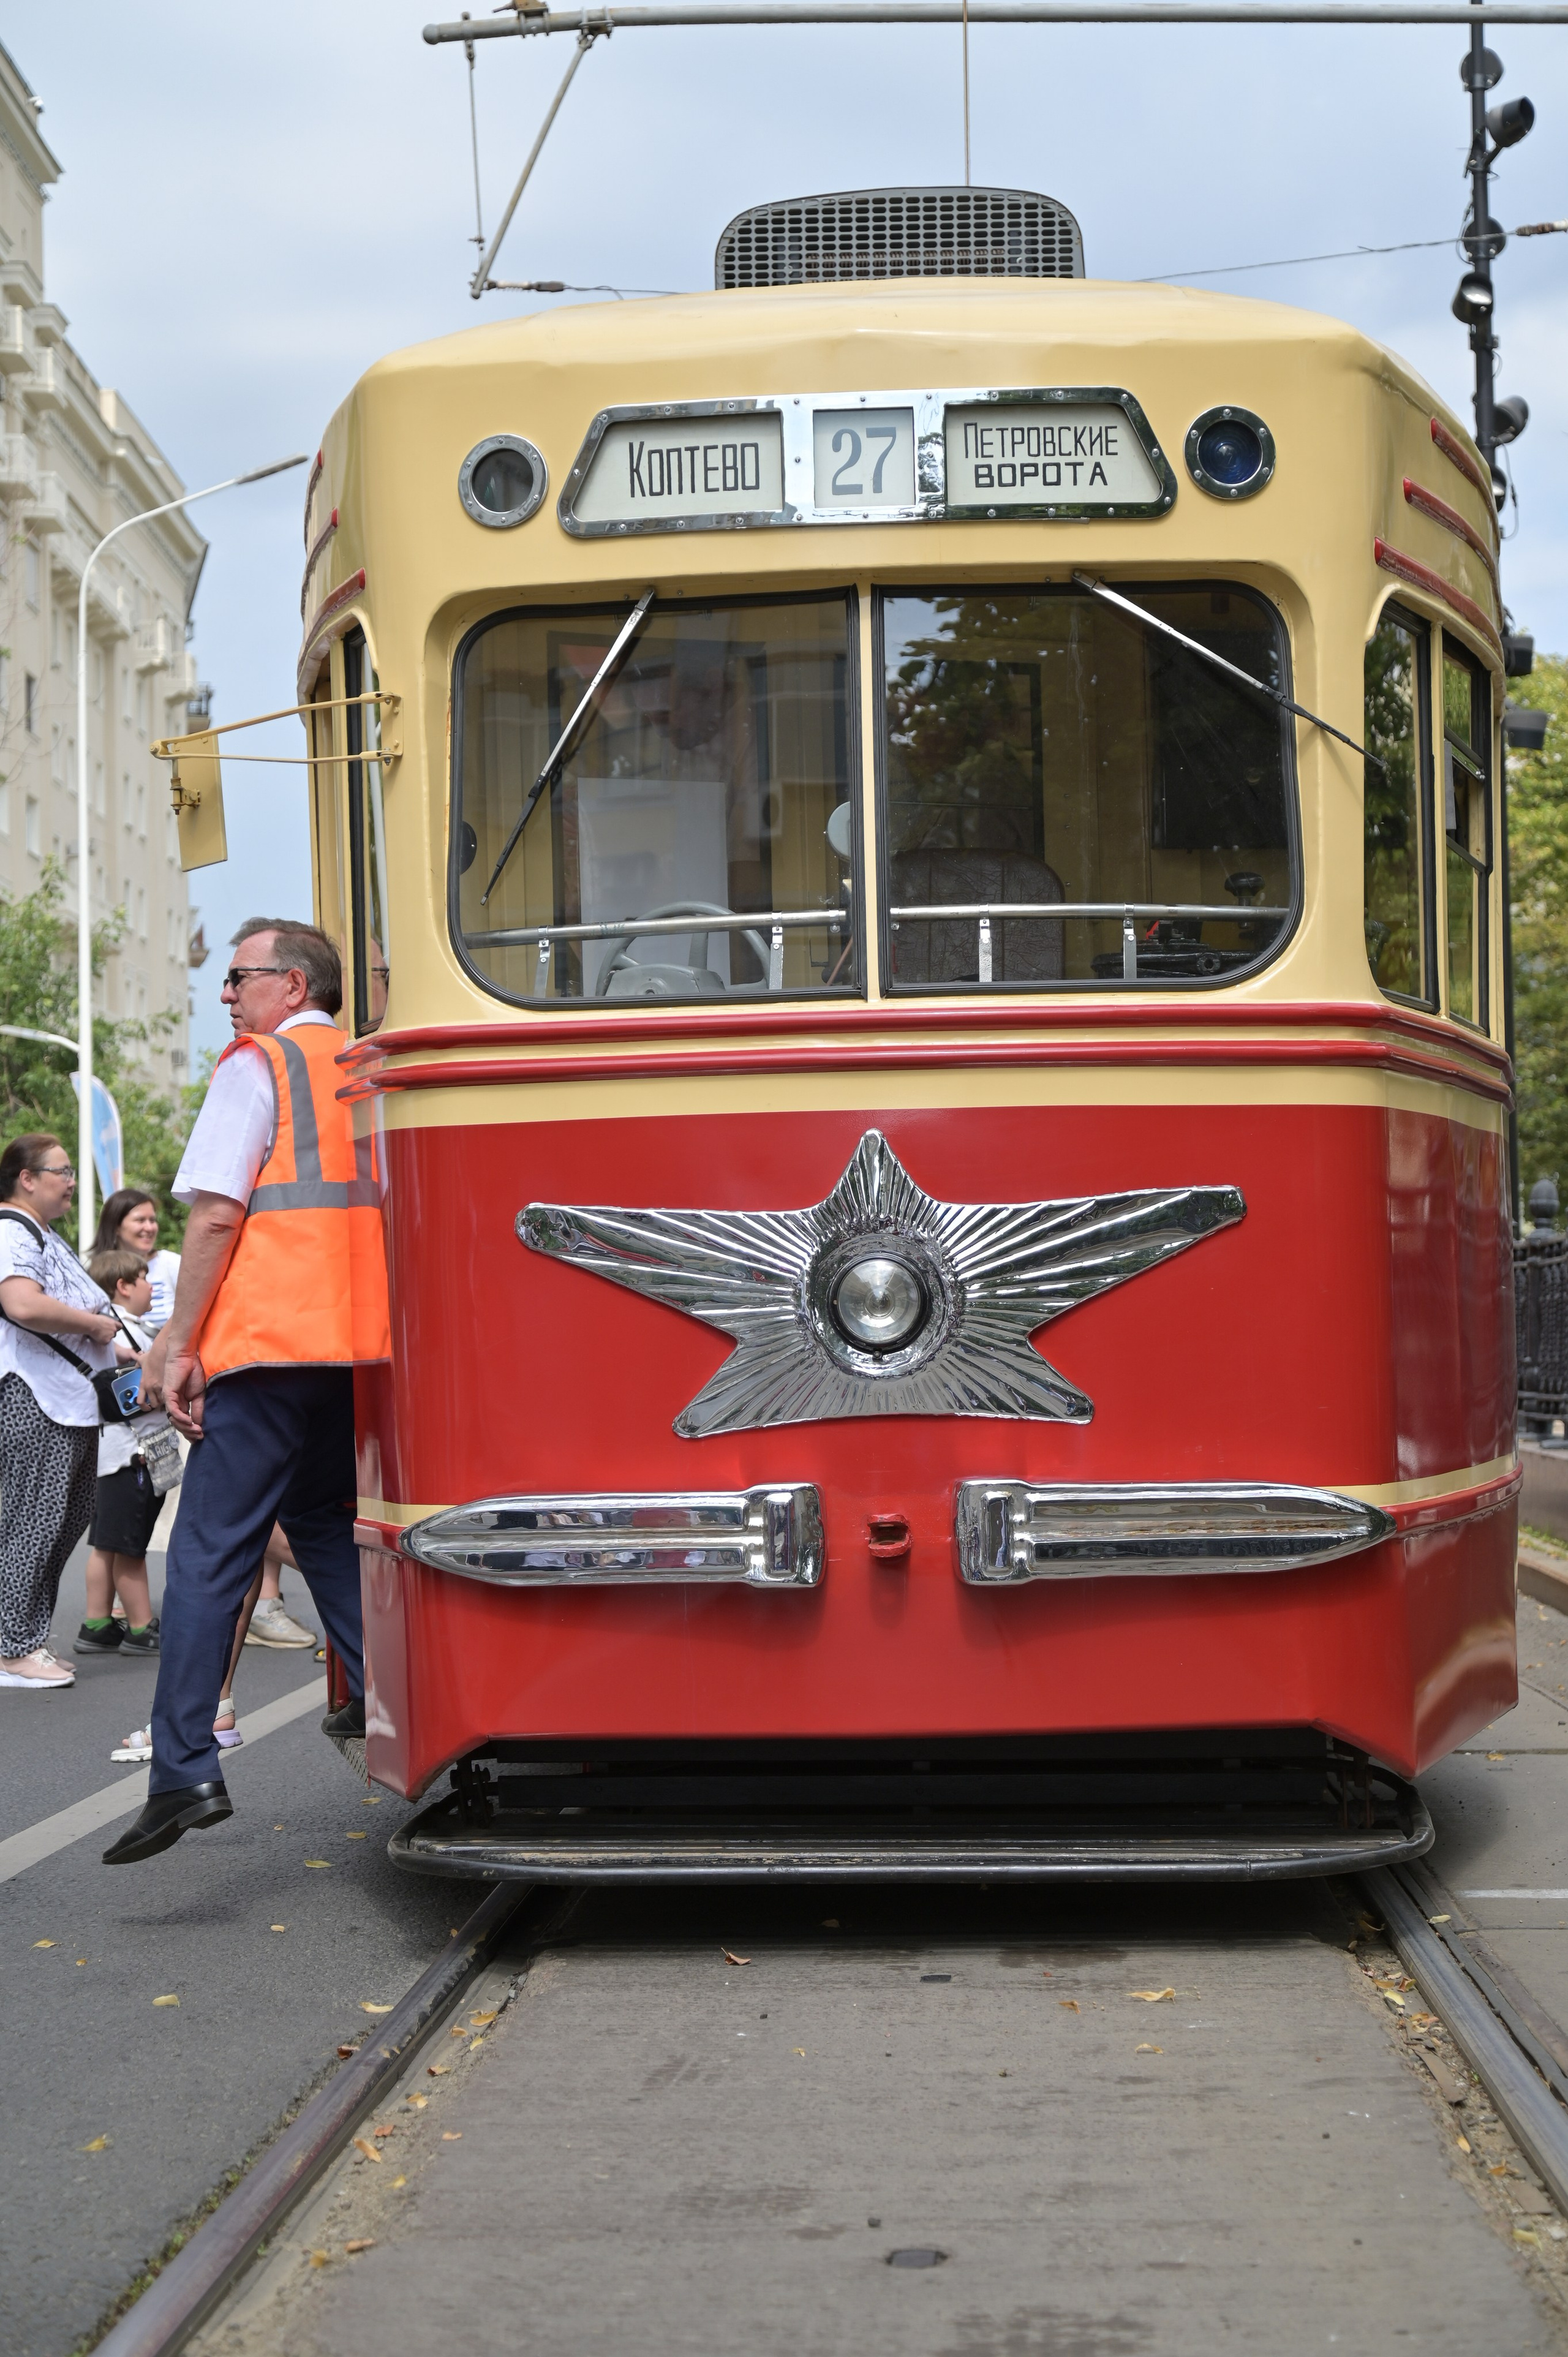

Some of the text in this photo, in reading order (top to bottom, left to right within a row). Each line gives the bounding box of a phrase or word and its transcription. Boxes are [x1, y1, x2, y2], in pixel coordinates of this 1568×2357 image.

[832, 426, 897, 496] 27
[963, 422, 1118, 458] ПЕТРОВСКИЕ
[629, 441, 760, 498] КОПТЕВО
[974, 461, 1108, 488] ВОРОТА
